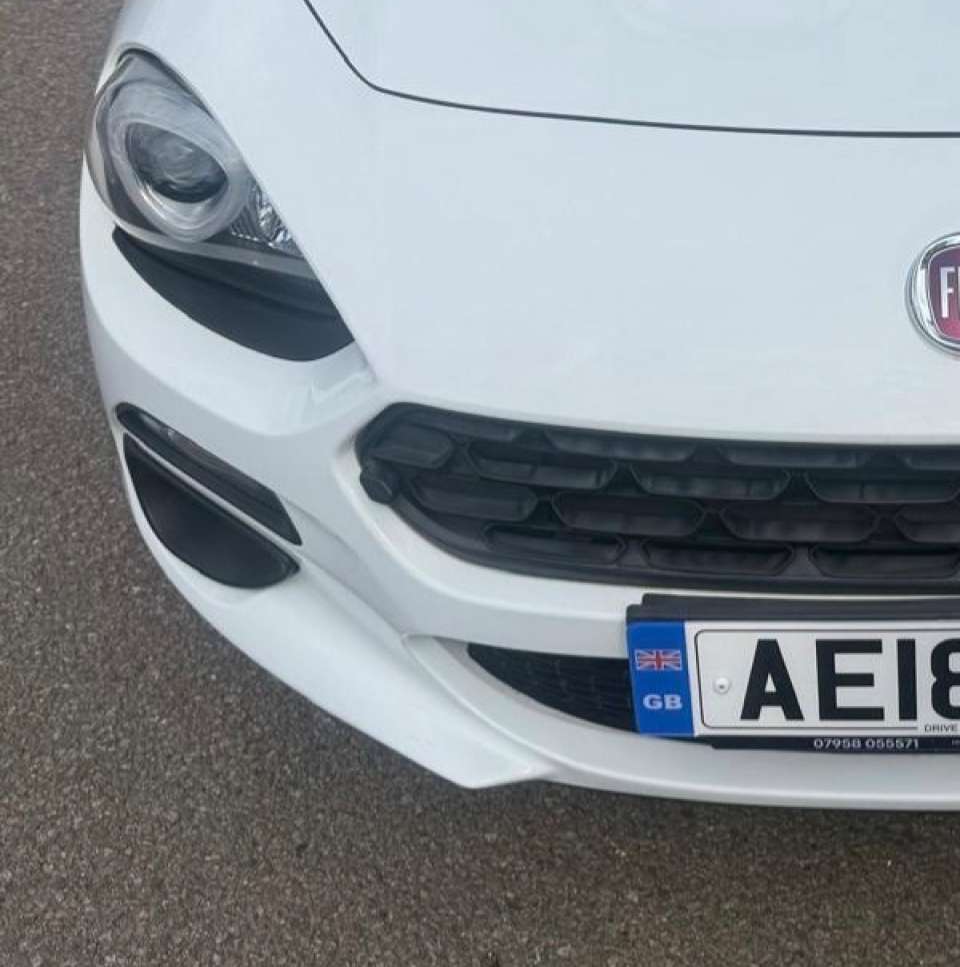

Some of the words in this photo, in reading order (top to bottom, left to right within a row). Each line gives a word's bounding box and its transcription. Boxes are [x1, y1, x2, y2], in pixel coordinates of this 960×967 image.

[643, 694, 683, 710] GB
[924, 724, 959, 733] DRIVE
[813, 737, 862, 750] 07958
[865, 737, 919, 750] 055571
